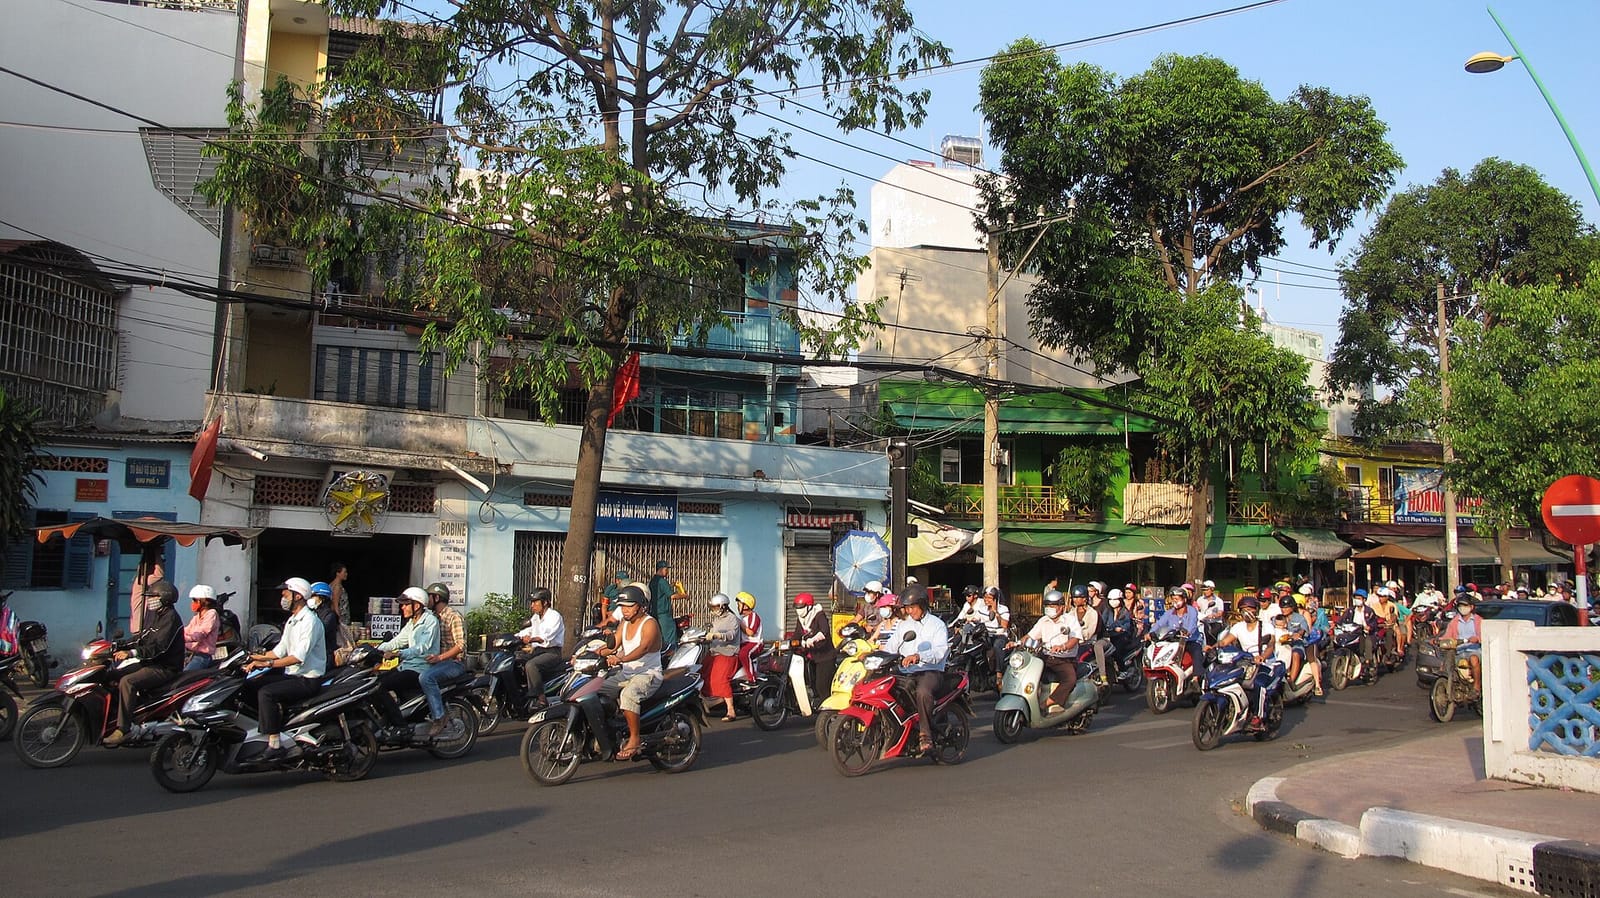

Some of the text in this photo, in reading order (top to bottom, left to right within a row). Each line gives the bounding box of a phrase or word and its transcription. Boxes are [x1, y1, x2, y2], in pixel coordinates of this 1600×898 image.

[600, 498, 613, 517] BẢO
[613, 500, 621, 521] VỆ
[621, 501, 634, 518] DÂN
[634, 499, 646, 519] PHỐ
[646, 501, 669, 520] PHƯỜNG
[669, 507, 674, 520] 3
[440, 521, 466, 536] BOBINE
